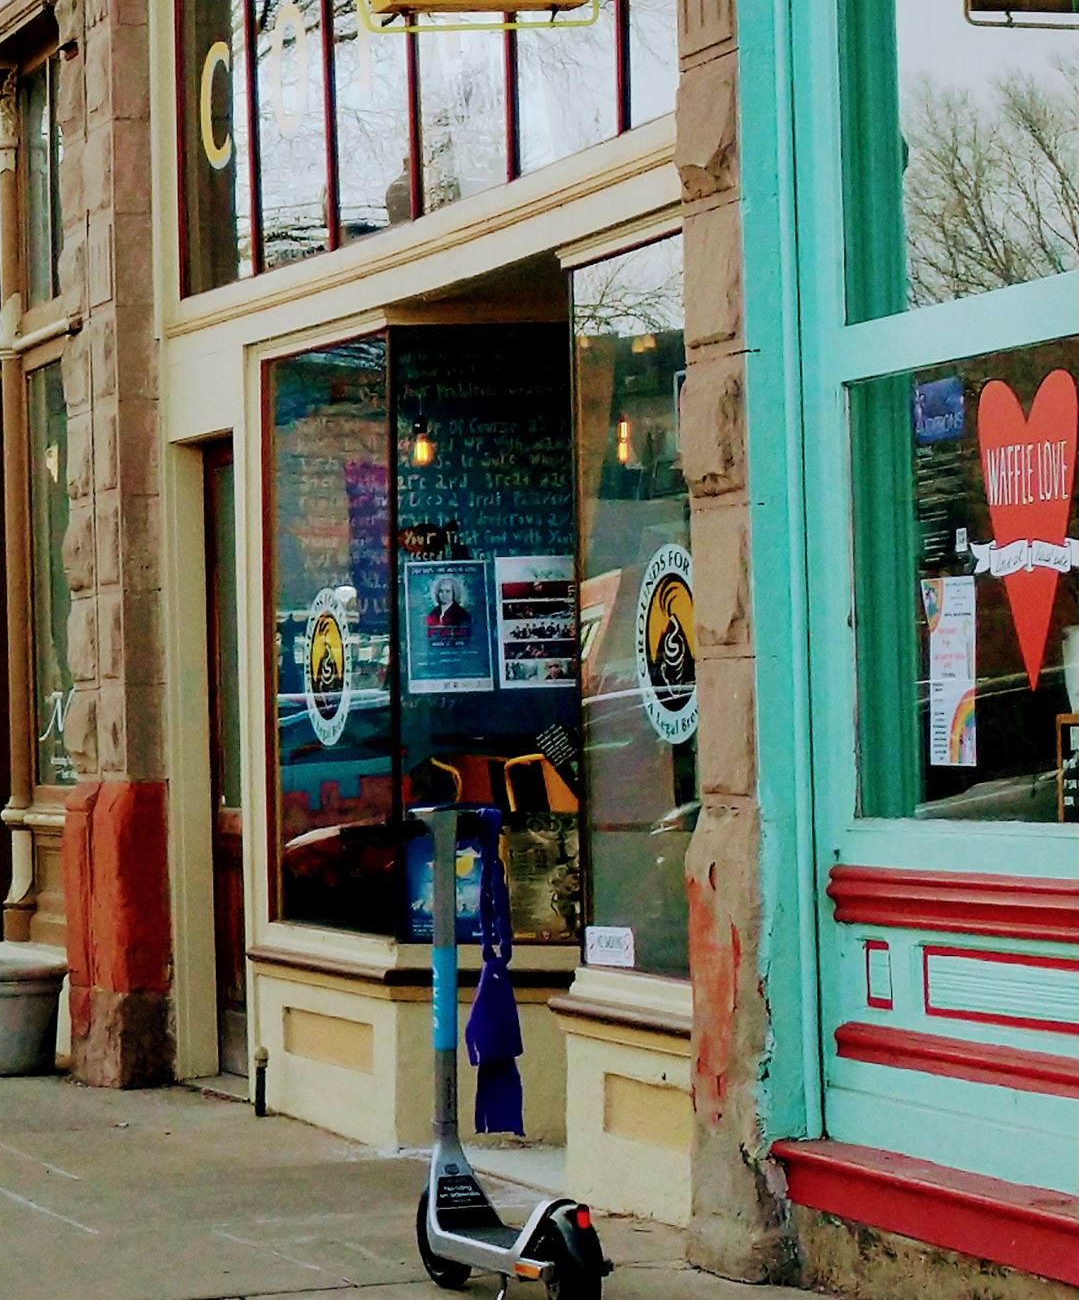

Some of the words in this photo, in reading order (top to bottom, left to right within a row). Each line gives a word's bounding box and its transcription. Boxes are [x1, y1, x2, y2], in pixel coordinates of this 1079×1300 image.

[987, 444, 1034, 506] WAFFLE
[1038, 439, 1069, 501] LOVE
[668, 550, 690, 576] FOR
